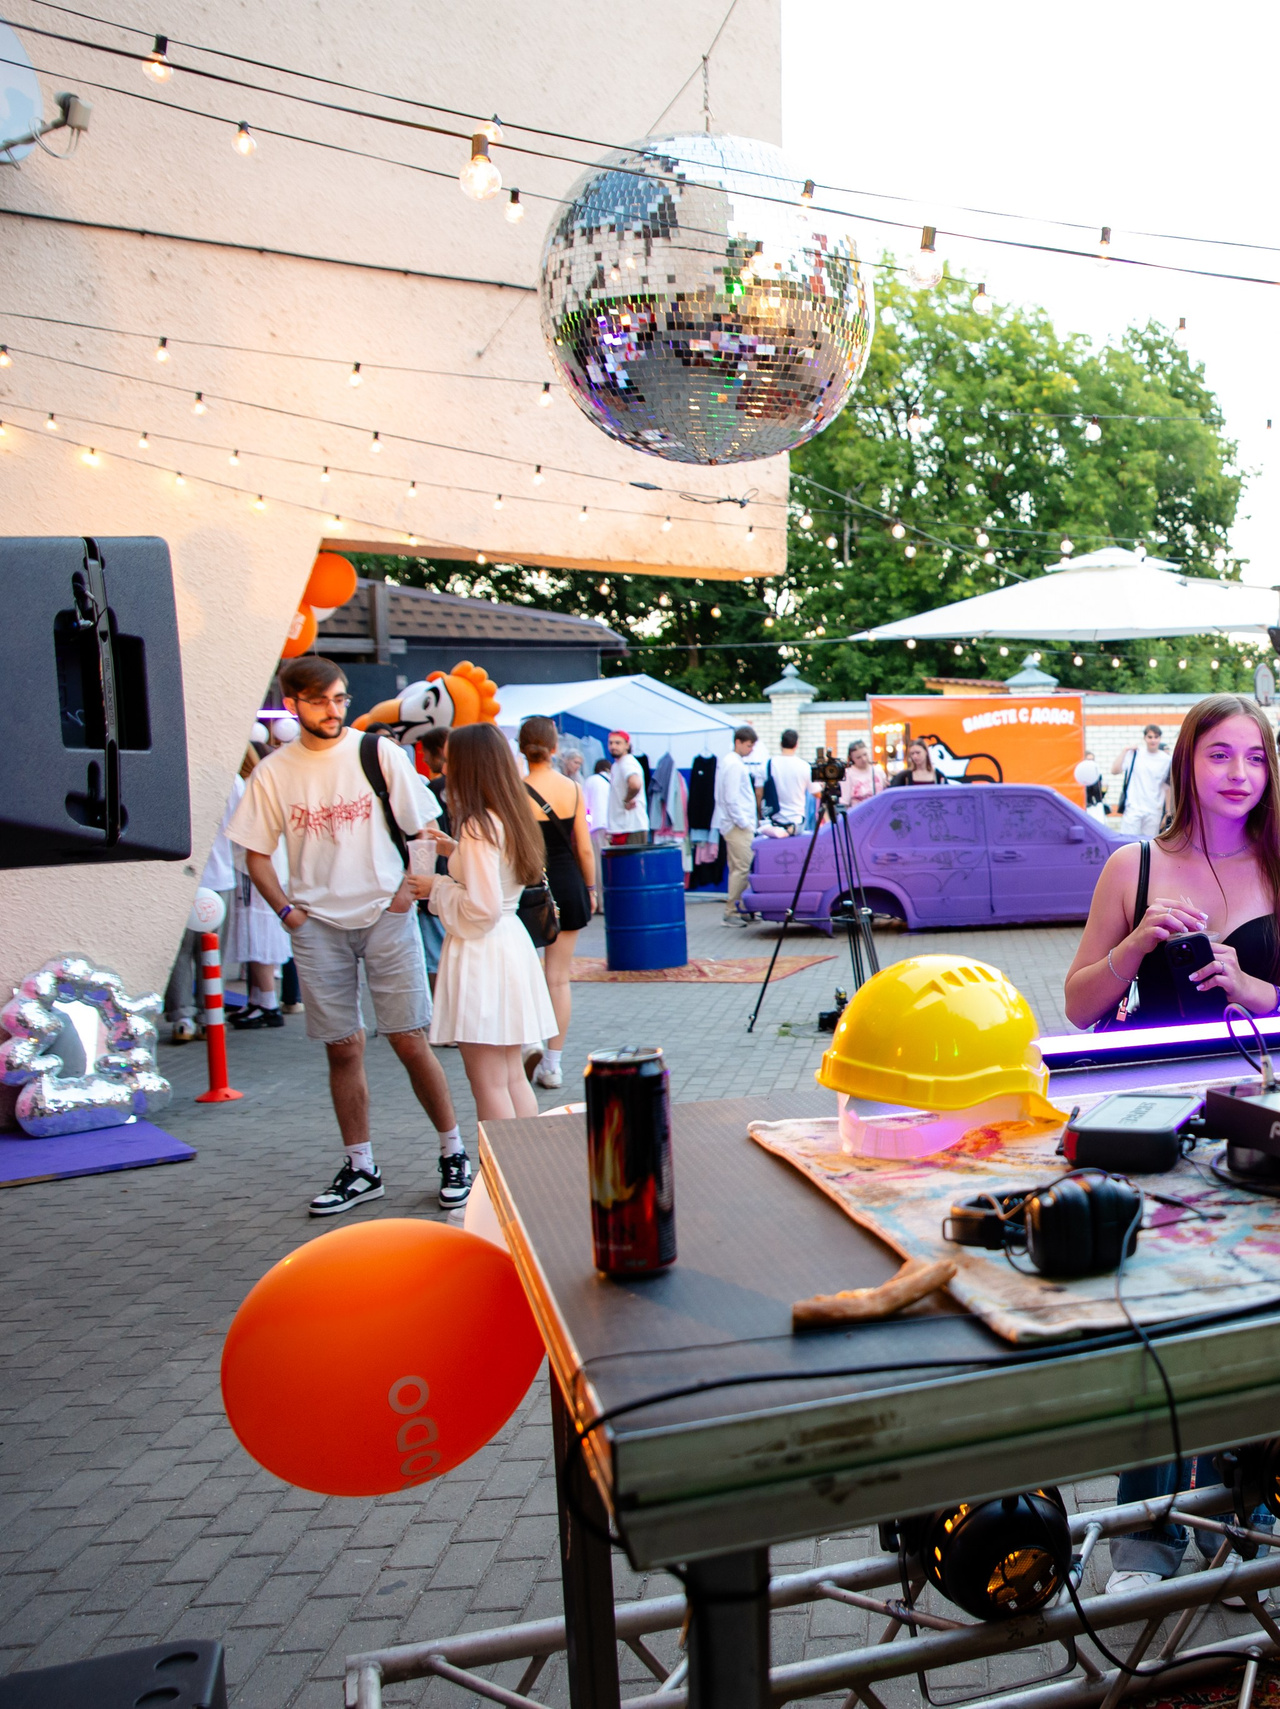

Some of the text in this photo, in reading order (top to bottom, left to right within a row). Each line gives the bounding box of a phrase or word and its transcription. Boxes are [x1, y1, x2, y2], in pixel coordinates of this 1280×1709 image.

[962, 707, 1075, 734] ВМЕСТЕ С ДОДО!
